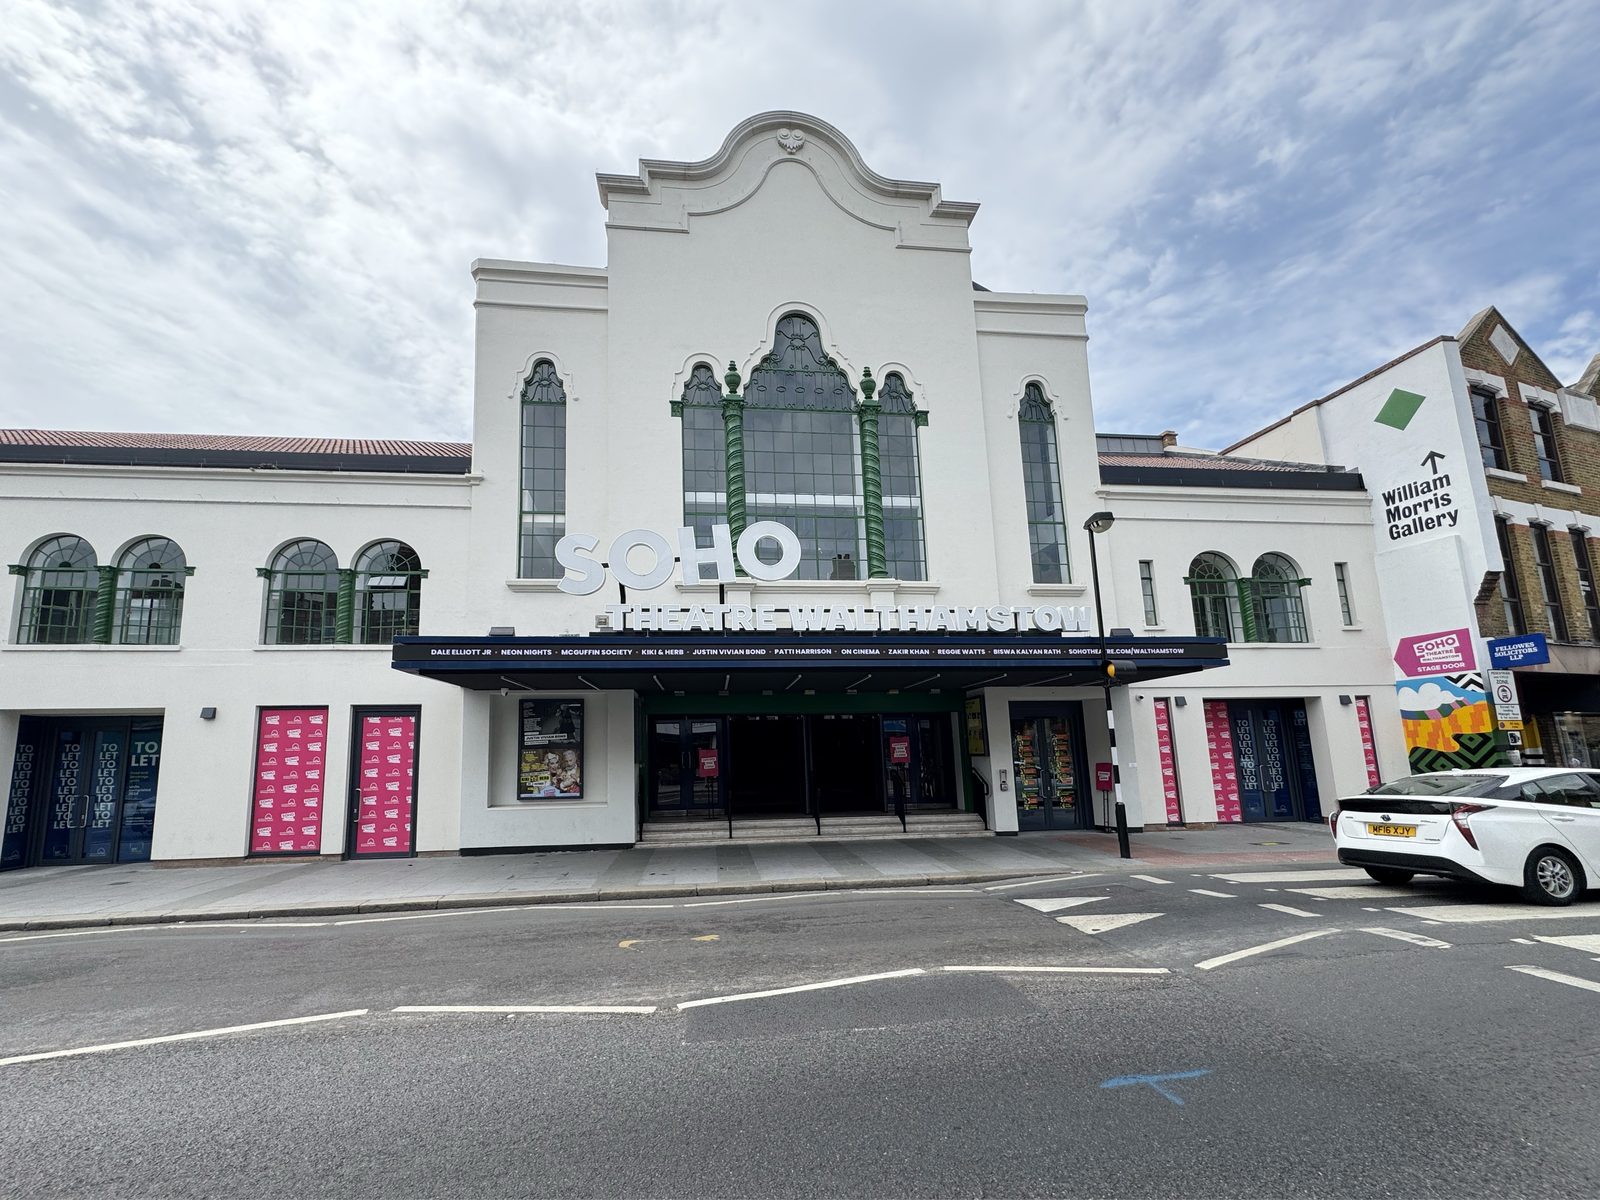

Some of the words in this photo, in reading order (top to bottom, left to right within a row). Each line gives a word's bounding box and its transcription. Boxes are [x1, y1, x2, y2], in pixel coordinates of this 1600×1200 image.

[1382, 474, 1450, 506] William
[1386, 493, 1452, 524] Morris
[1389, 509, 1458, 540] Gallery
[555, 520, 801, 596] SOHO
[606, 604, 777, 631] THEATRE
[788, 604, 1091, 632] WALTHAMSTOW
[1416, 637, 1456, 654] SOHO
[1495, 642, 1534, 652] FELLOWES
[1426, 648, 1454, 656] THEATRE
[1494, 647, 1538, 658] SOLICITORS
[19, 744, 34, 753] TO
[65, 744, 80, 752] TO
[135, 742, 158, 753] TO
[16, 753, 34, 762] LET
[62, 752, 80, 760] LET
[131, 755, 159, 766] LET
[17, 762, 31, 770] TO
[14, 771, 32, 779] LET
[60, 769, 79, 777] LET
[14, 780, 29, 788] TO
[12, 788, 30, 797] LET
[12, 797, 27, 806] TO
[9, 806, 27, 815] LET
[10, 815, 25, 824] TO
[7, 824, 25, 833] LET
[1393, 827, 1410, 835] XJY
